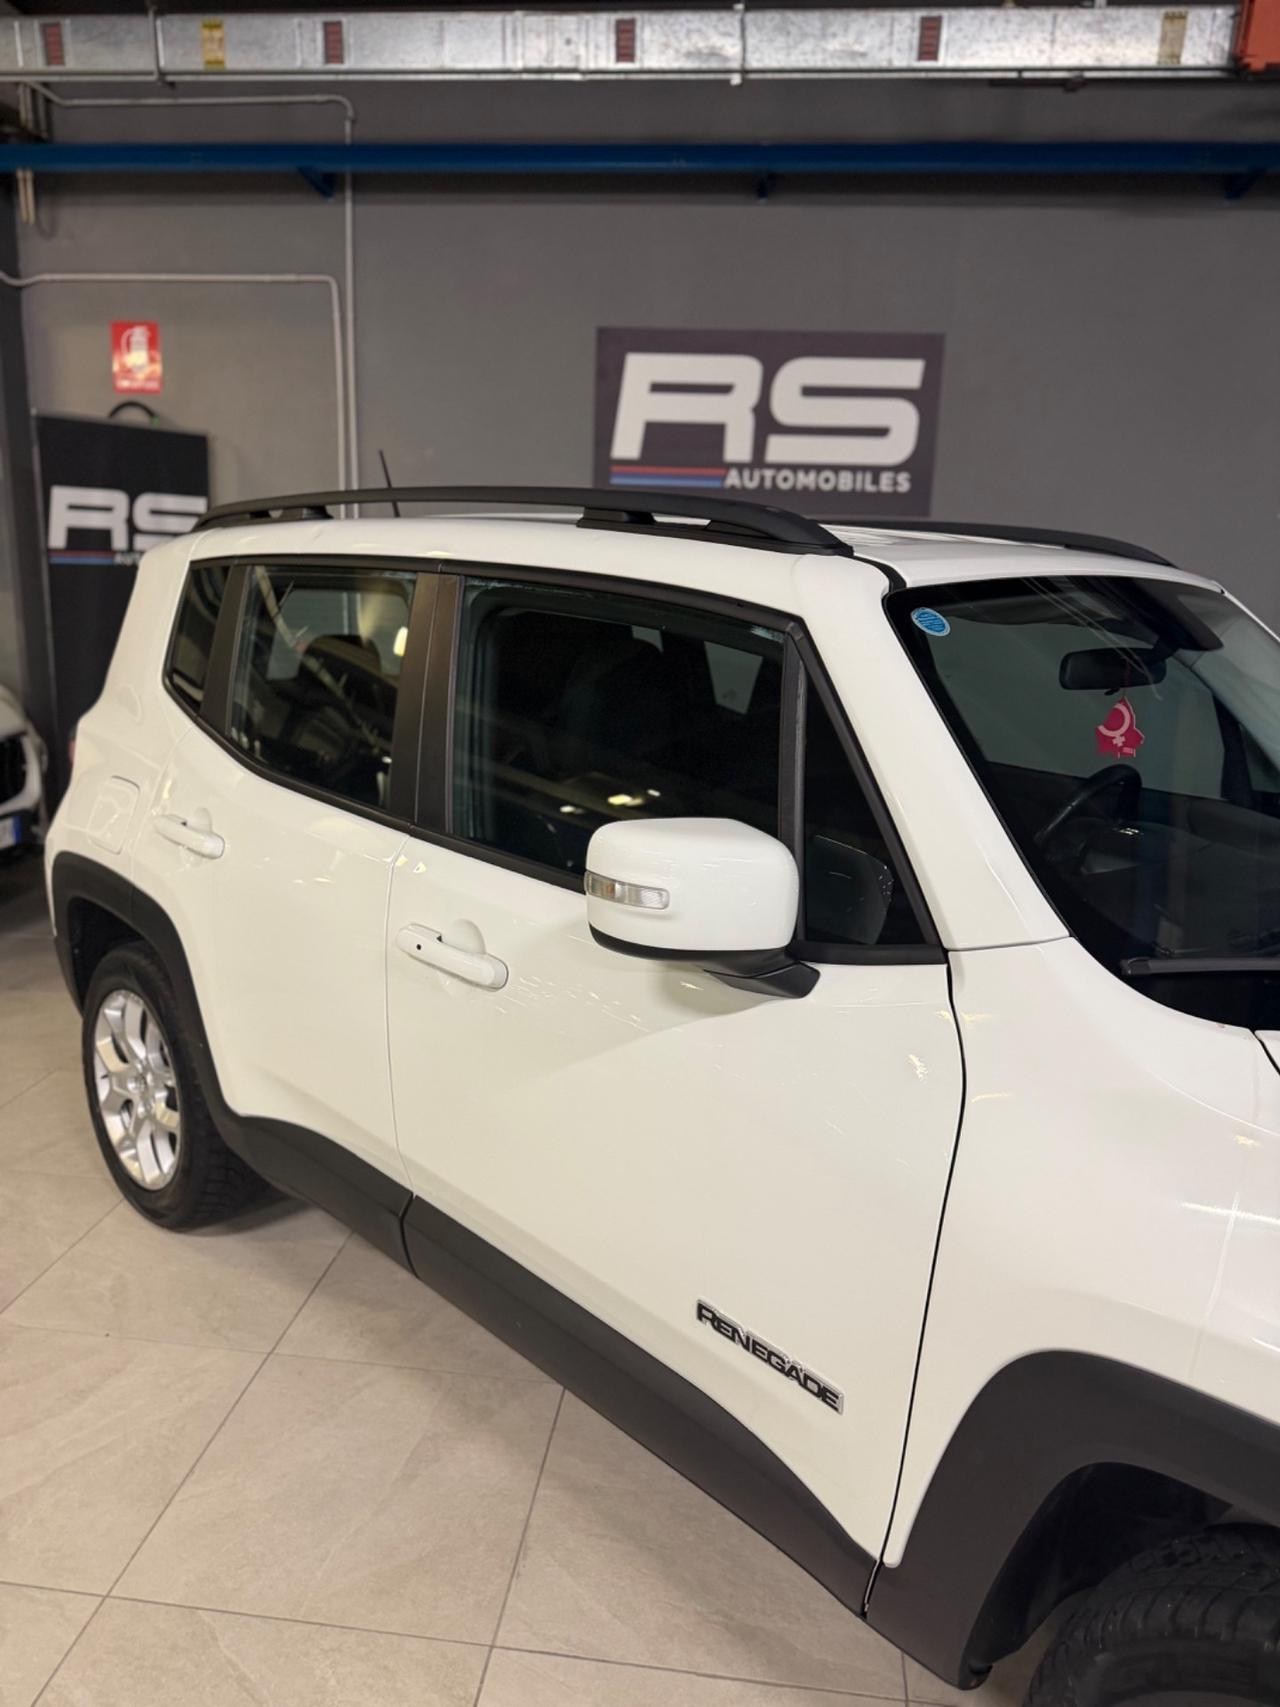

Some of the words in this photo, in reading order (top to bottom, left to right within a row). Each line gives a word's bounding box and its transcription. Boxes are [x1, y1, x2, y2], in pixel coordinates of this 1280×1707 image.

[610, 352, 925, 466] RS
[48, 485, 208, 551] RS
[724, 468, 911, 492] AUTOMOBILES
[697, 1300, 842, 1414] RENEGADE
